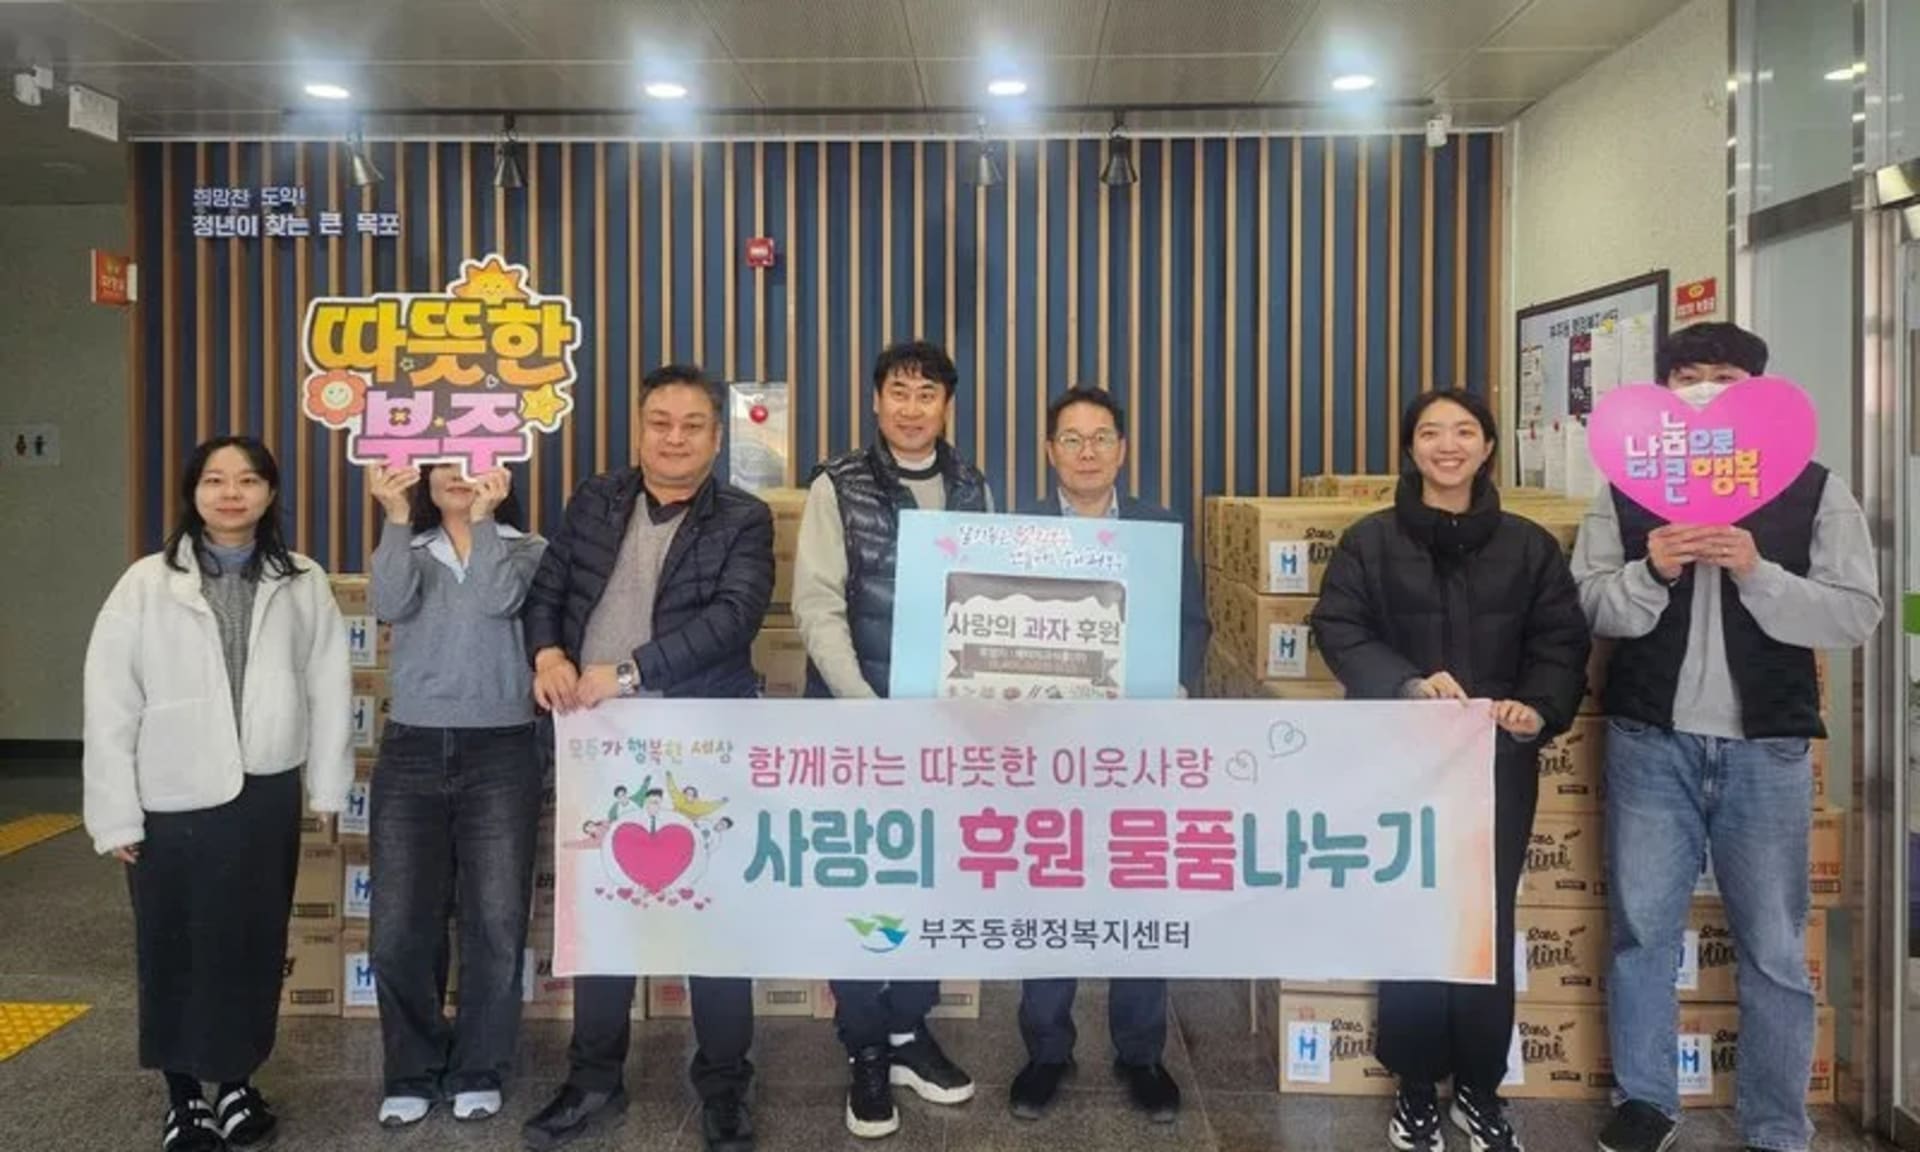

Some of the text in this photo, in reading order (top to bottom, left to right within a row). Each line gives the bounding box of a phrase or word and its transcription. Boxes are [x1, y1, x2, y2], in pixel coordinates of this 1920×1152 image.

[261, 186, 305, 206] 도약!
[265, 212, 309, 236] 찾는
[319, 212, 342, 236] 큰
[357, 212, 400, 236] 목포
[310, 300, 573, 388] 따뜻한
[355, 390, 524, 475] 부주
[1625, 411, 1735, 457] 나눔으로
[1626, 450, 1760, 505] 더 큰 행복
[947, 612, 1121, 646] 사랑의 과자 후원
[691, 738, 734, 764] 세상
[748, 744, 1214, 789] 함께하는 따뜻한 이웃사랑
[743, 805, 1437, 892] 사랑의 후원 물품나누기
[919, 917, 1192, 951] 부주동행정복지센터
